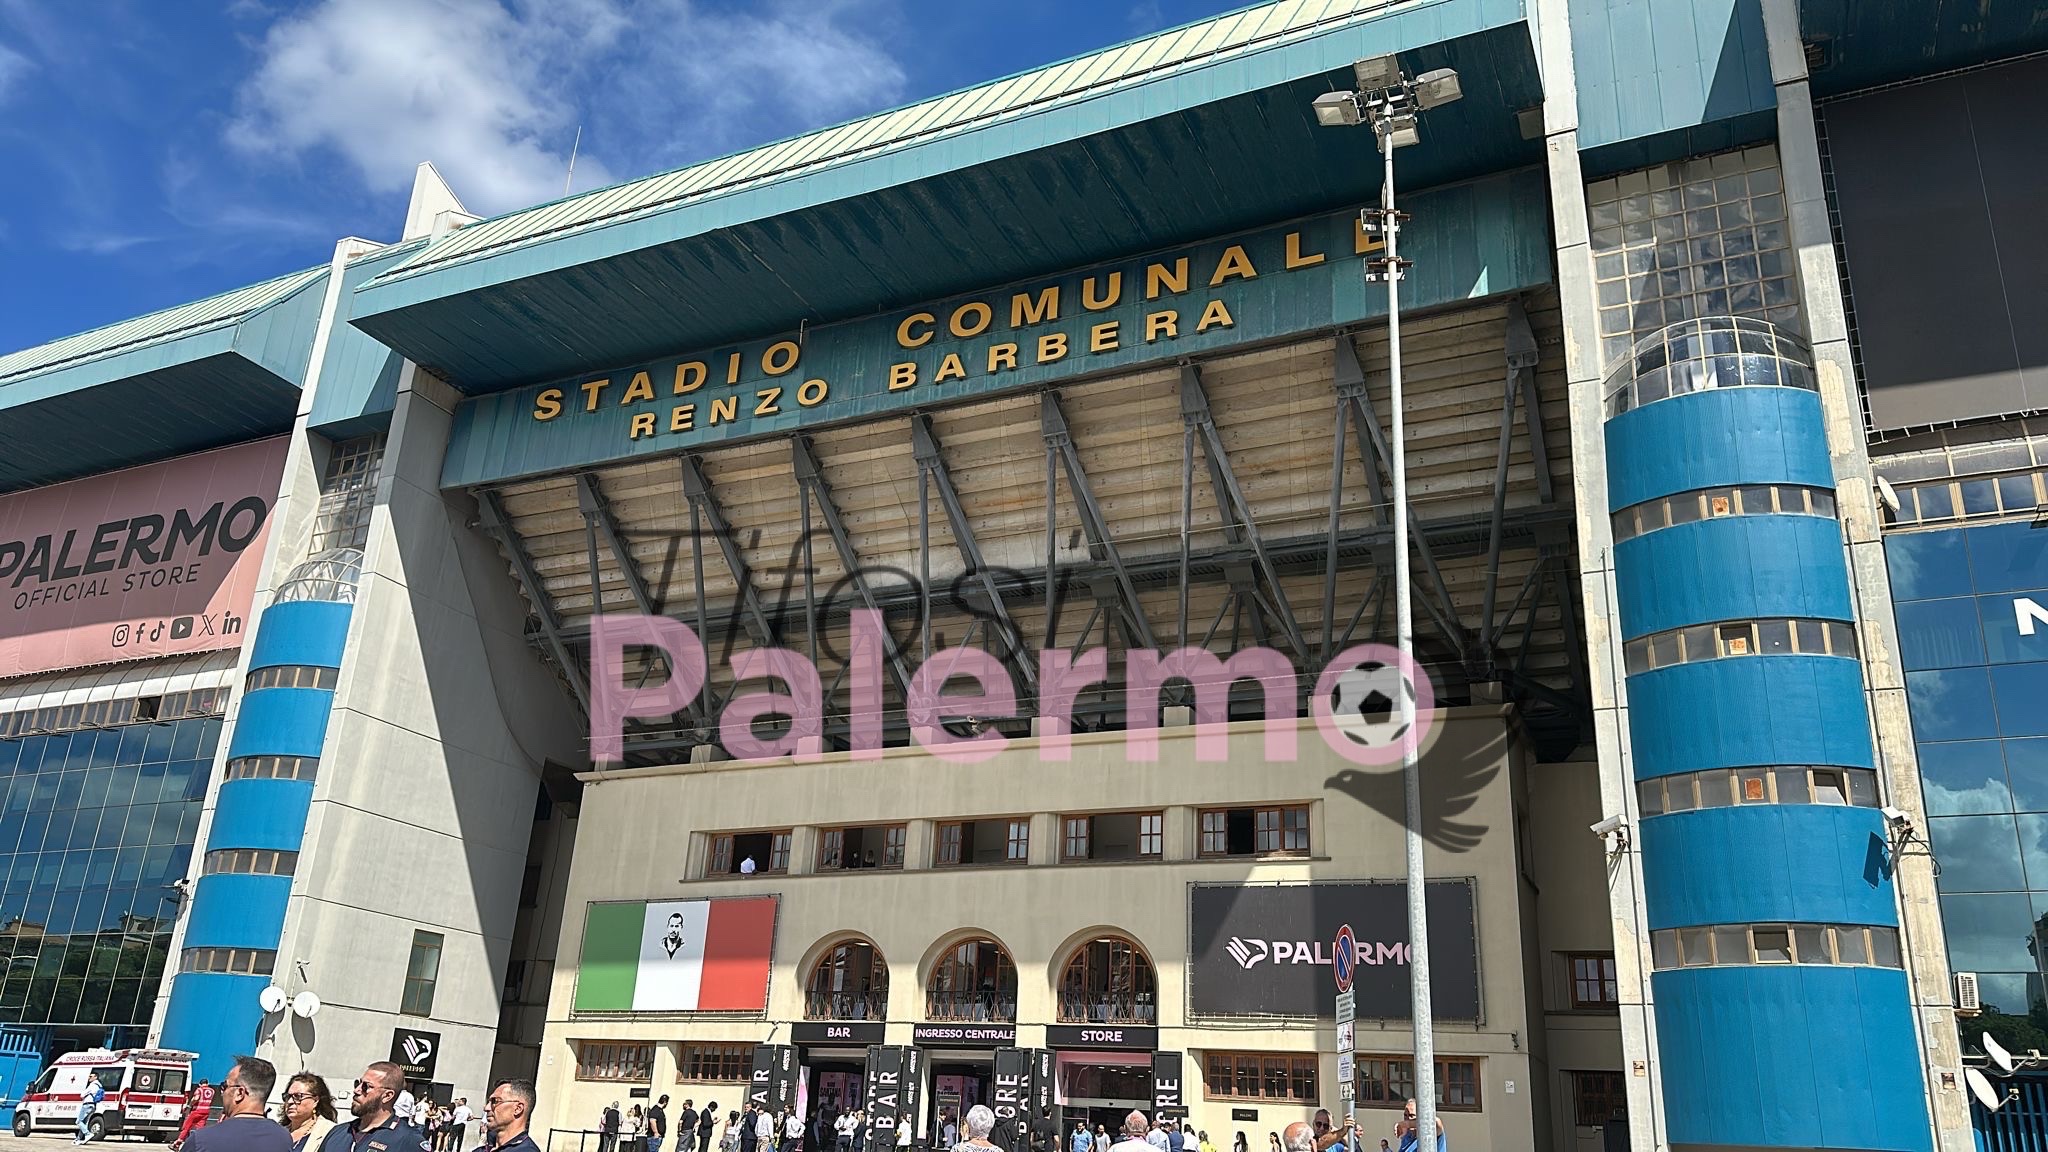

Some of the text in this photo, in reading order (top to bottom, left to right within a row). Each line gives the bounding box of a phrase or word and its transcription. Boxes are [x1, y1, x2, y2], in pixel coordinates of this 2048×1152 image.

[533, 341, 800, 421] STADIO
[630, 299, 1235, 439] RENZO BARBERA
[0, 496, 267, 588] PALERMO
[14, 563, 201, 610] OFFICIAL STORE
[1272, 941, 1411, 965] PALRM
[827, 1027, 850, 1038] BAR
[915, 1028, 1015, 1040] INGRESSO CENTRALE
[1081, 1030, 1123, 1043] STORE
[751, 1069, 770, 1104] AR
[876, 1071, 899, 1129] BAR
[994, 1074, 1019, 1119] ORE
